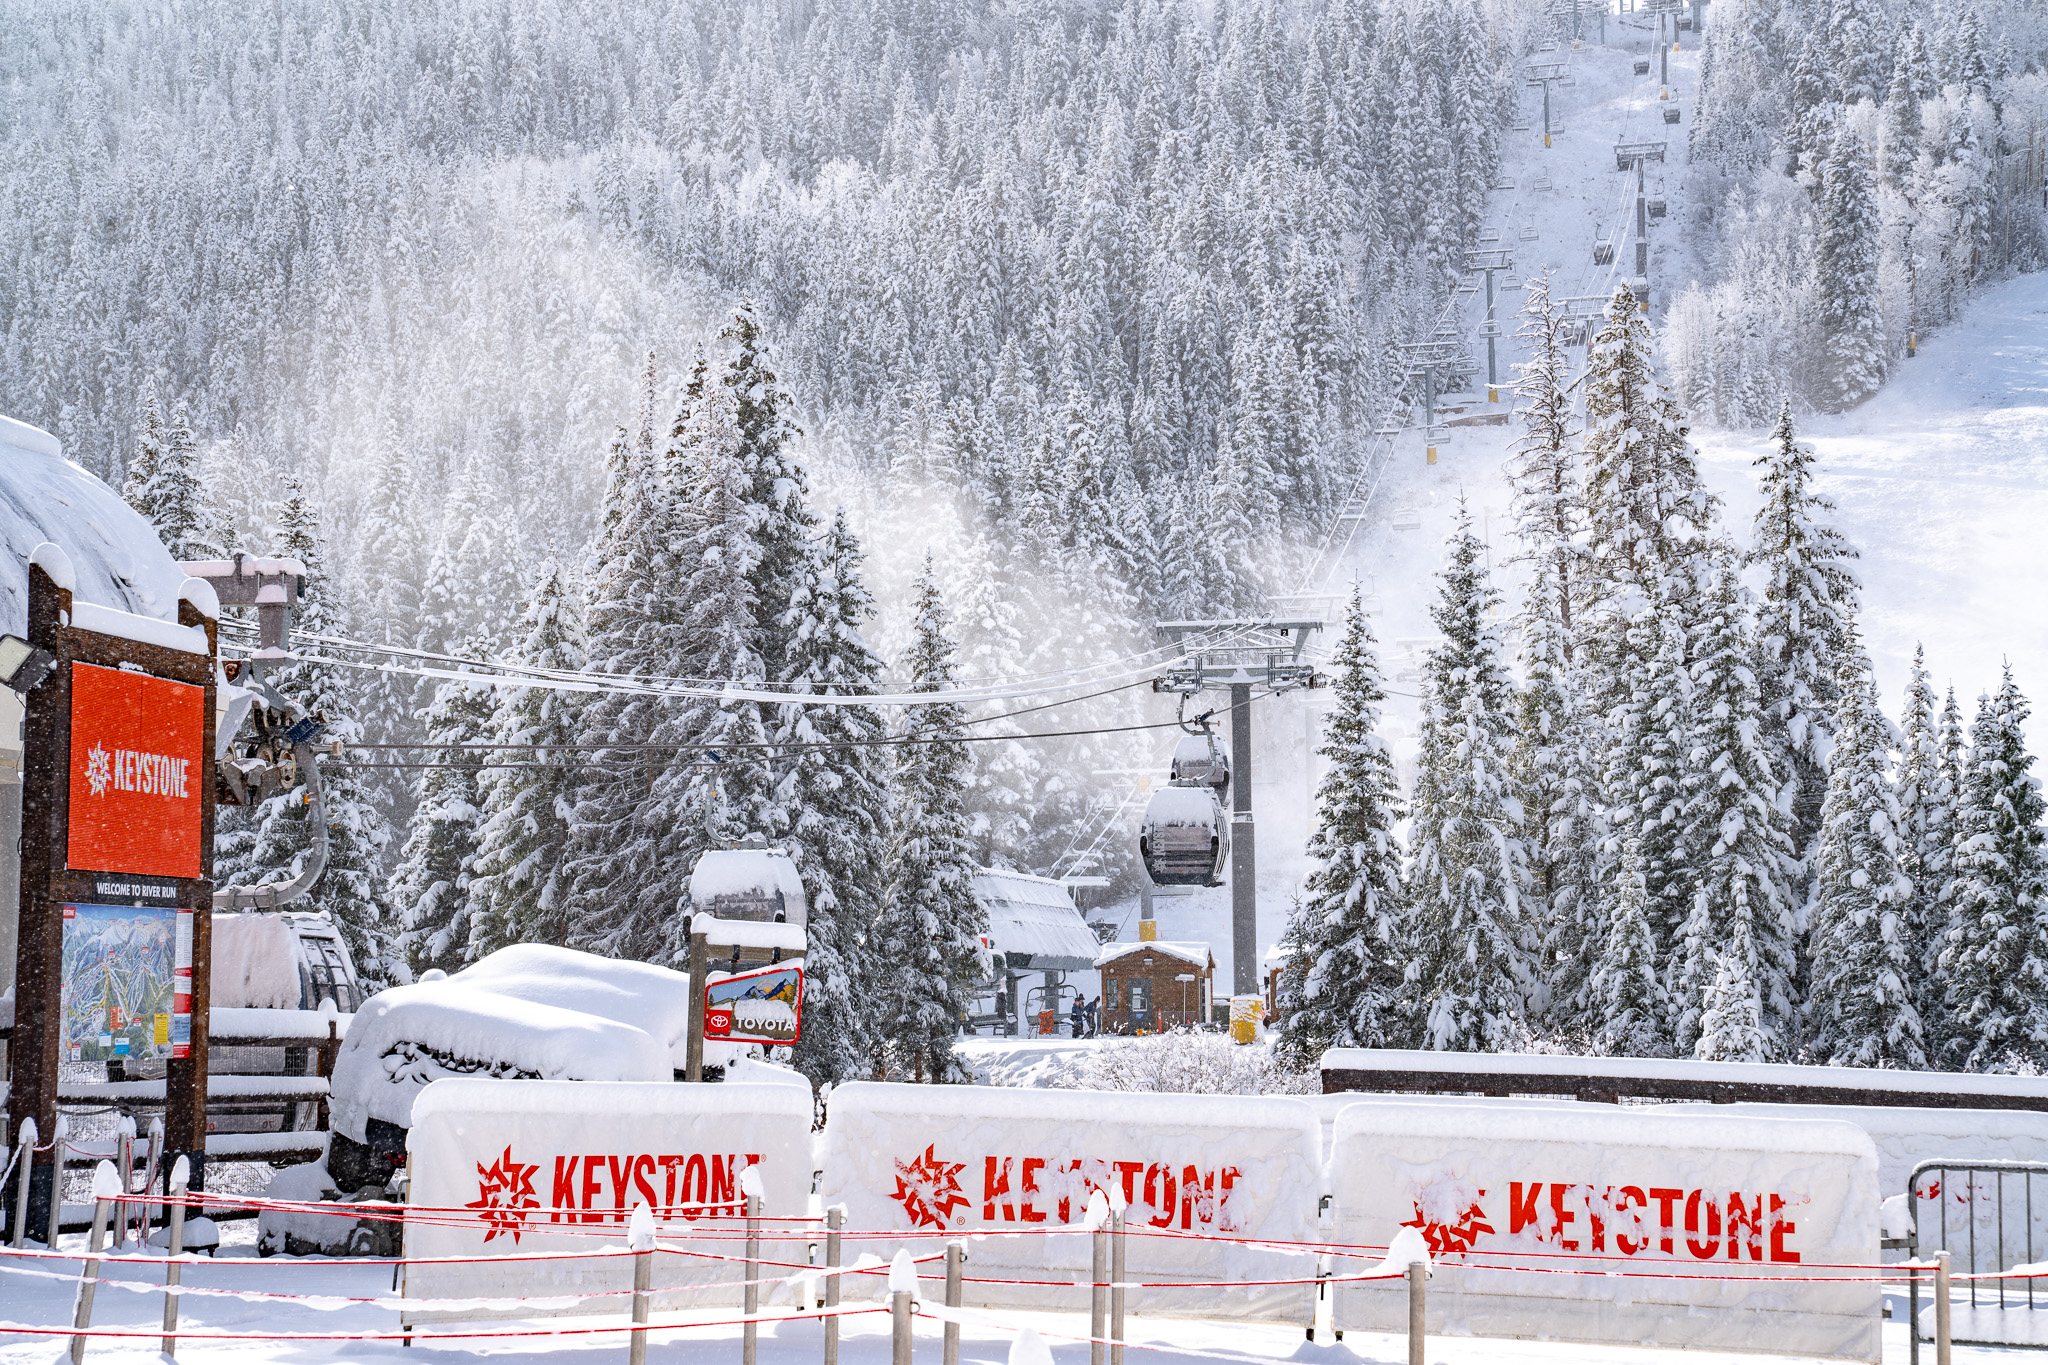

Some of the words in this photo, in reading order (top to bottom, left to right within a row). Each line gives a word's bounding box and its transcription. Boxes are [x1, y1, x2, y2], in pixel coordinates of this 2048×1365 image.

[114, 749, 189, 798] KEYSTONE
[97, 882, 130, 896] WELCOME
[131, 884, 140, 896] TO
[141, 885, 161, 898] RIVER
[162, 886, 176, 898] RUN
[735, 1017, 795, 1032] TOYOTA
[983, 1155, 1242, 1232] KETON
